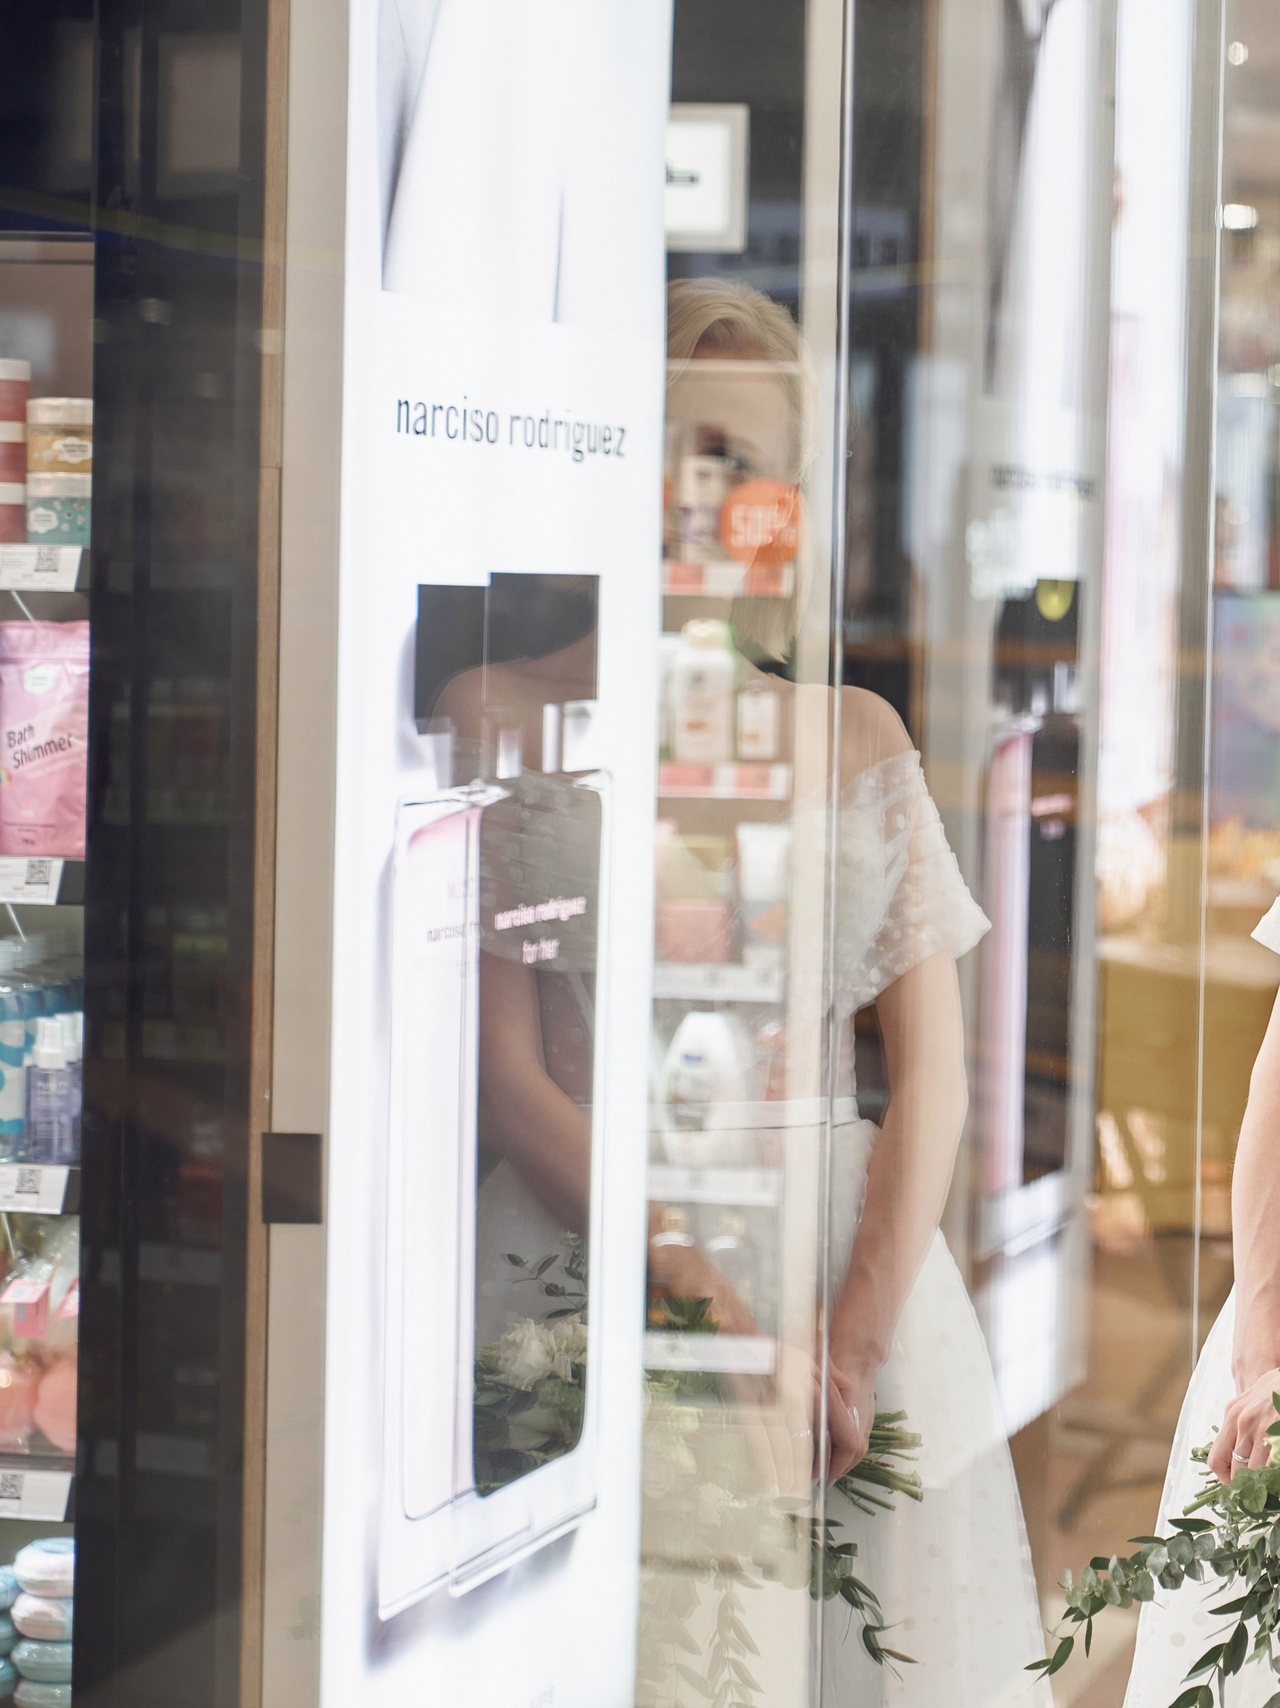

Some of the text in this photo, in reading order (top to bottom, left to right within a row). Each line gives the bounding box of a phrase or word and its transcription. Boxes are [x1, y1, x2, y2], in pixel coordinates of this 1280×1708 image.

[397, 396, 626, 462] narciso rodriguez
[6, 723, 35, 748] Bath
[13, 733, 73, 769] Shimmer
